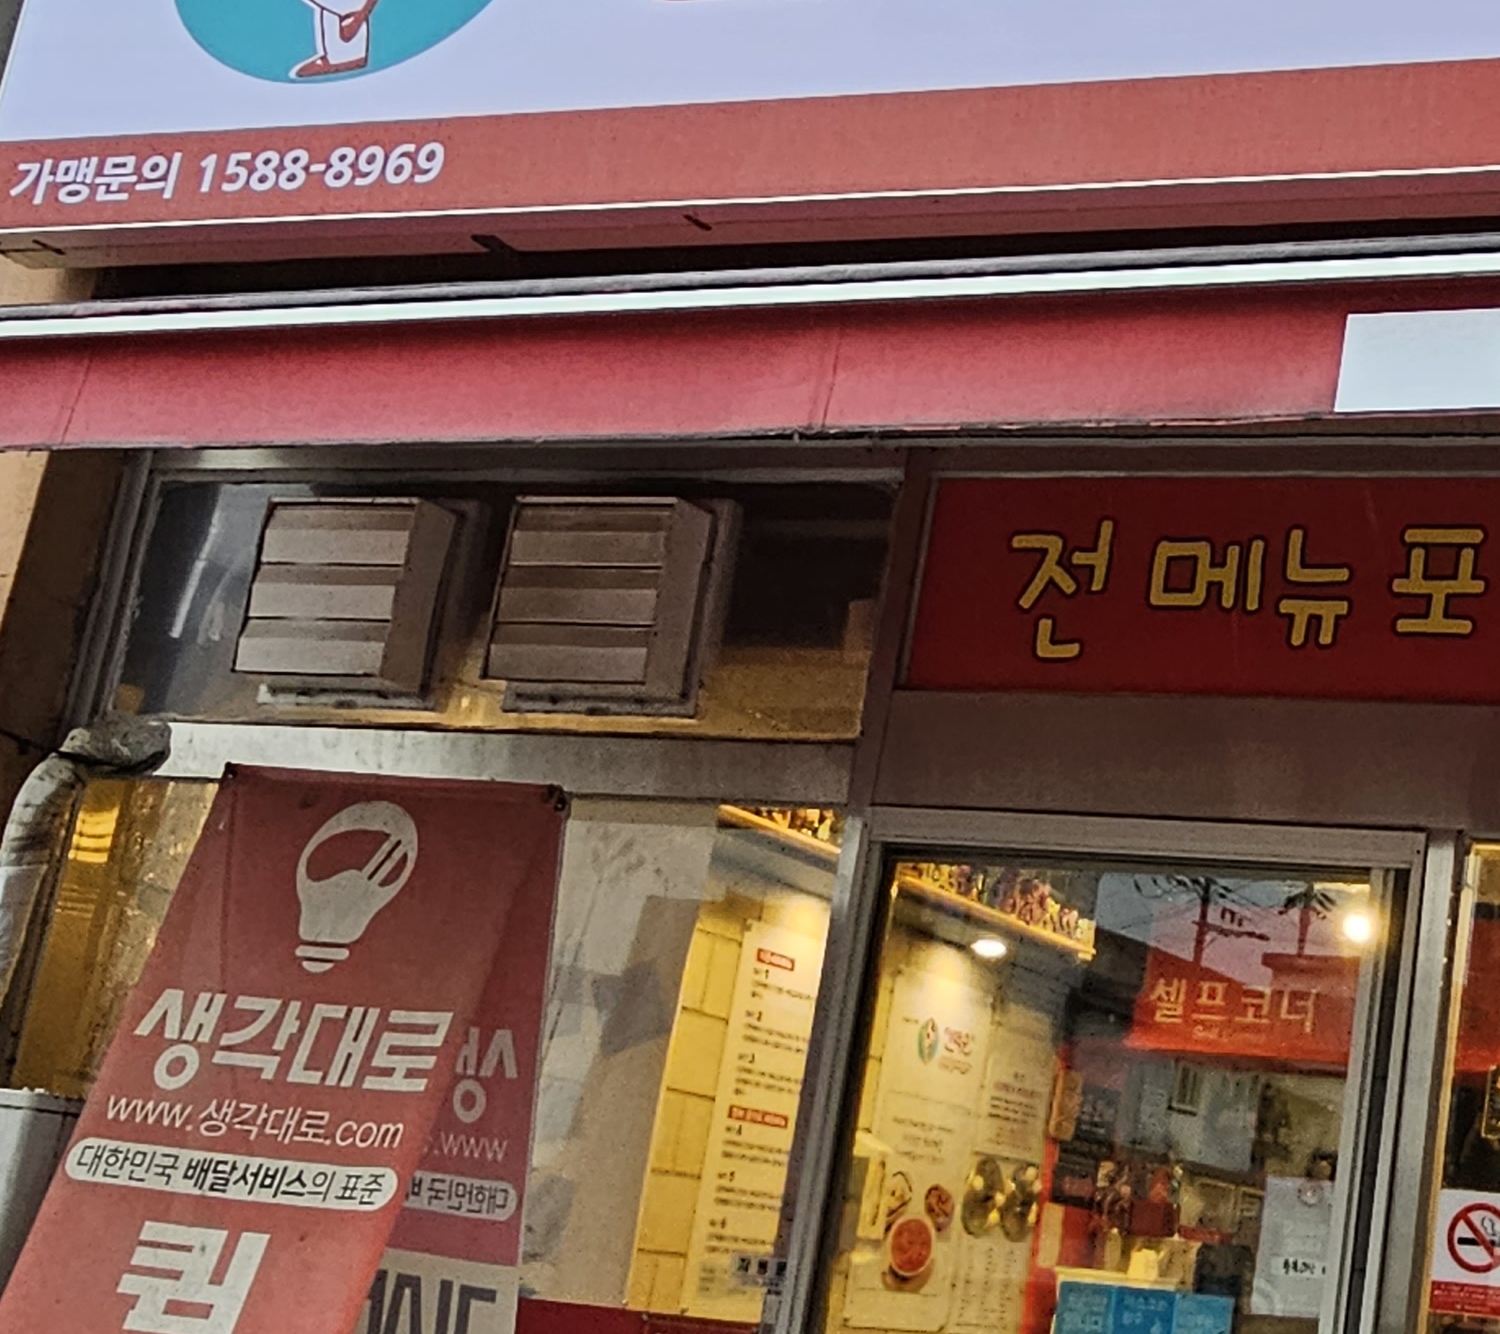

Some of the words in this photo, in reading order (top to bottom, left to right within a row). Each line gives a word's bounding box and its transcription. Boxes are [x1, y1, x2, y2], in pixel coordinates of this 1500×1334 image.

[10, 151, 181, 206] 가맹문의
[197, 141, 445, 195] 1588-8969
[1150, 976, 1321, 1034] 셀프코너
[134, 988, 454, 1093] 생각대로
[107, 1095, 405, 1151] www.생각대로.com
[75, 1144, 181, 1187] 대한민국
[182, 1156, 336, 1204] 배달서비스의
[334, 1172, 386, 1206] 표준
